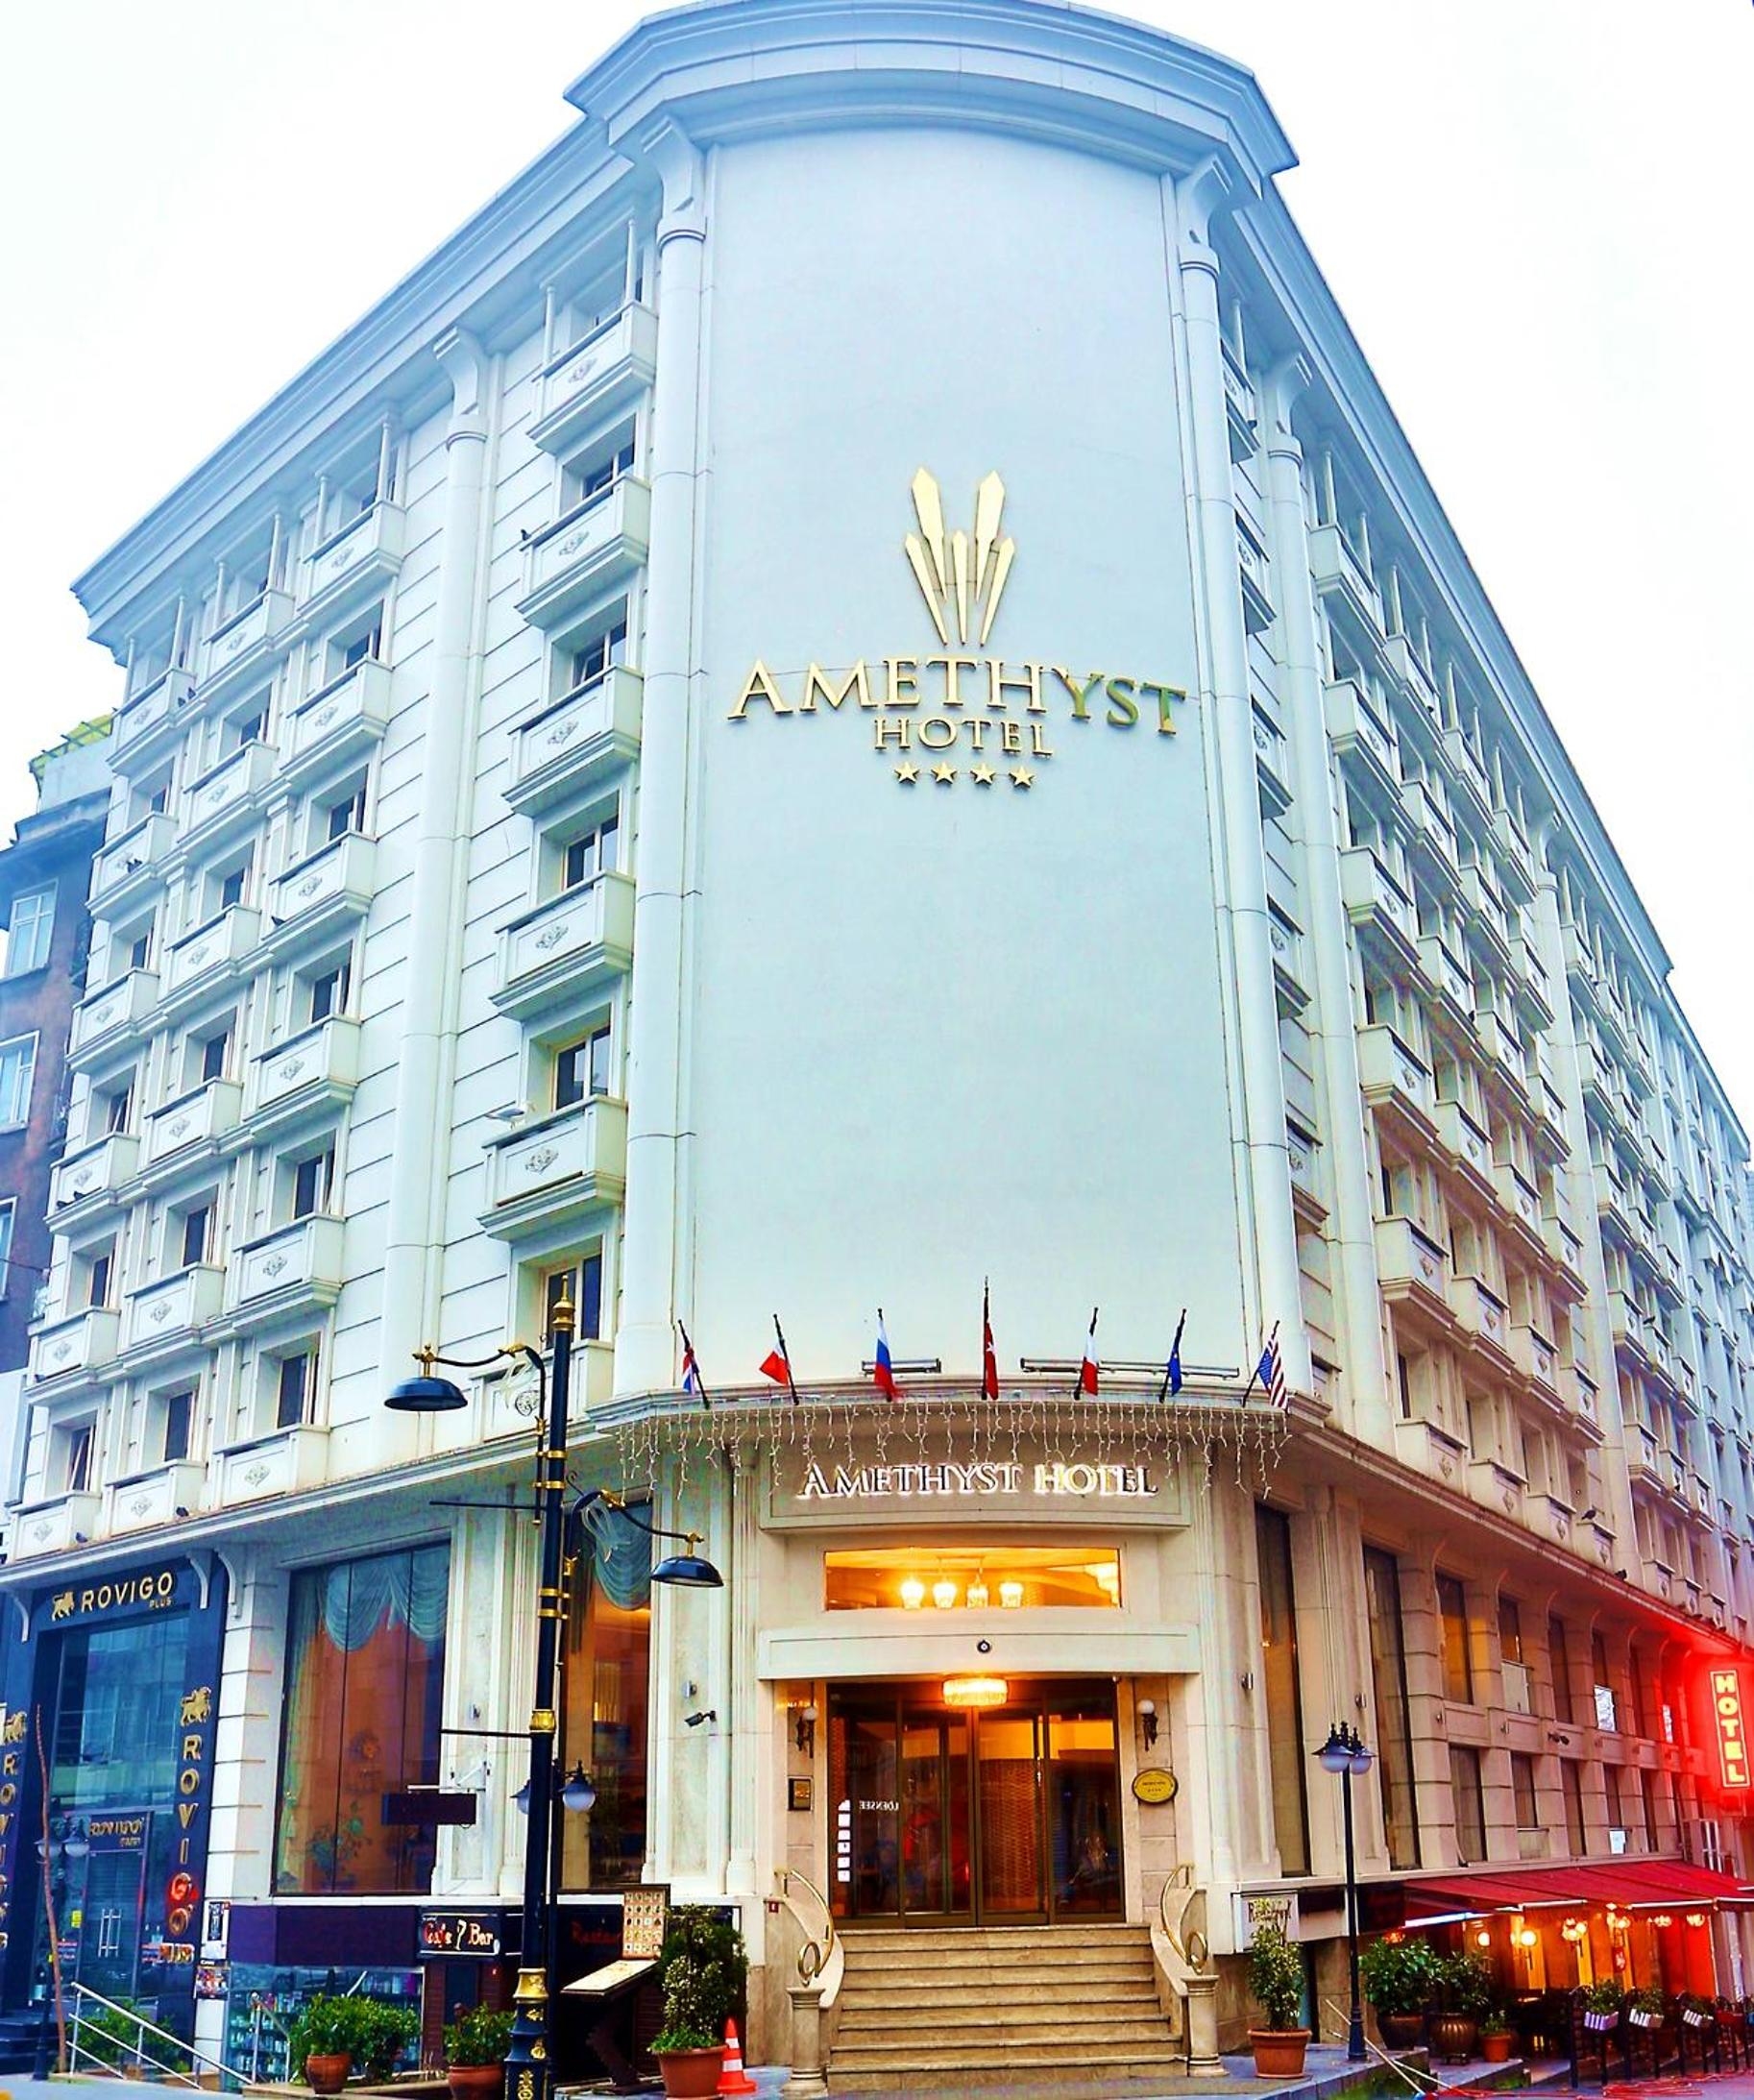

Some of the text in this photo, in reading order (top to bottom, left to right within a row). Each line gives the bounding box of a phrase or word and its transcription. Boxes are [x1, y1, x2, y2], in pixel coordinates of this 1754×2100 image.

[727, 656, 1186, 735] AMETHYST
[873, 719, 1054, 757] HOTEL
[797, 1462, 1158, 1500] AMETHYST HOTEL
[81, 1572, 173, 1613] ROVIGO
[149, 1596, 172, 1609] PLUS
[1715, 1674, 1746, 1783] HOTEL
[168, 1734, 202, 1935] ROVIGO
[467, 1922, 494, 1946] Bar
